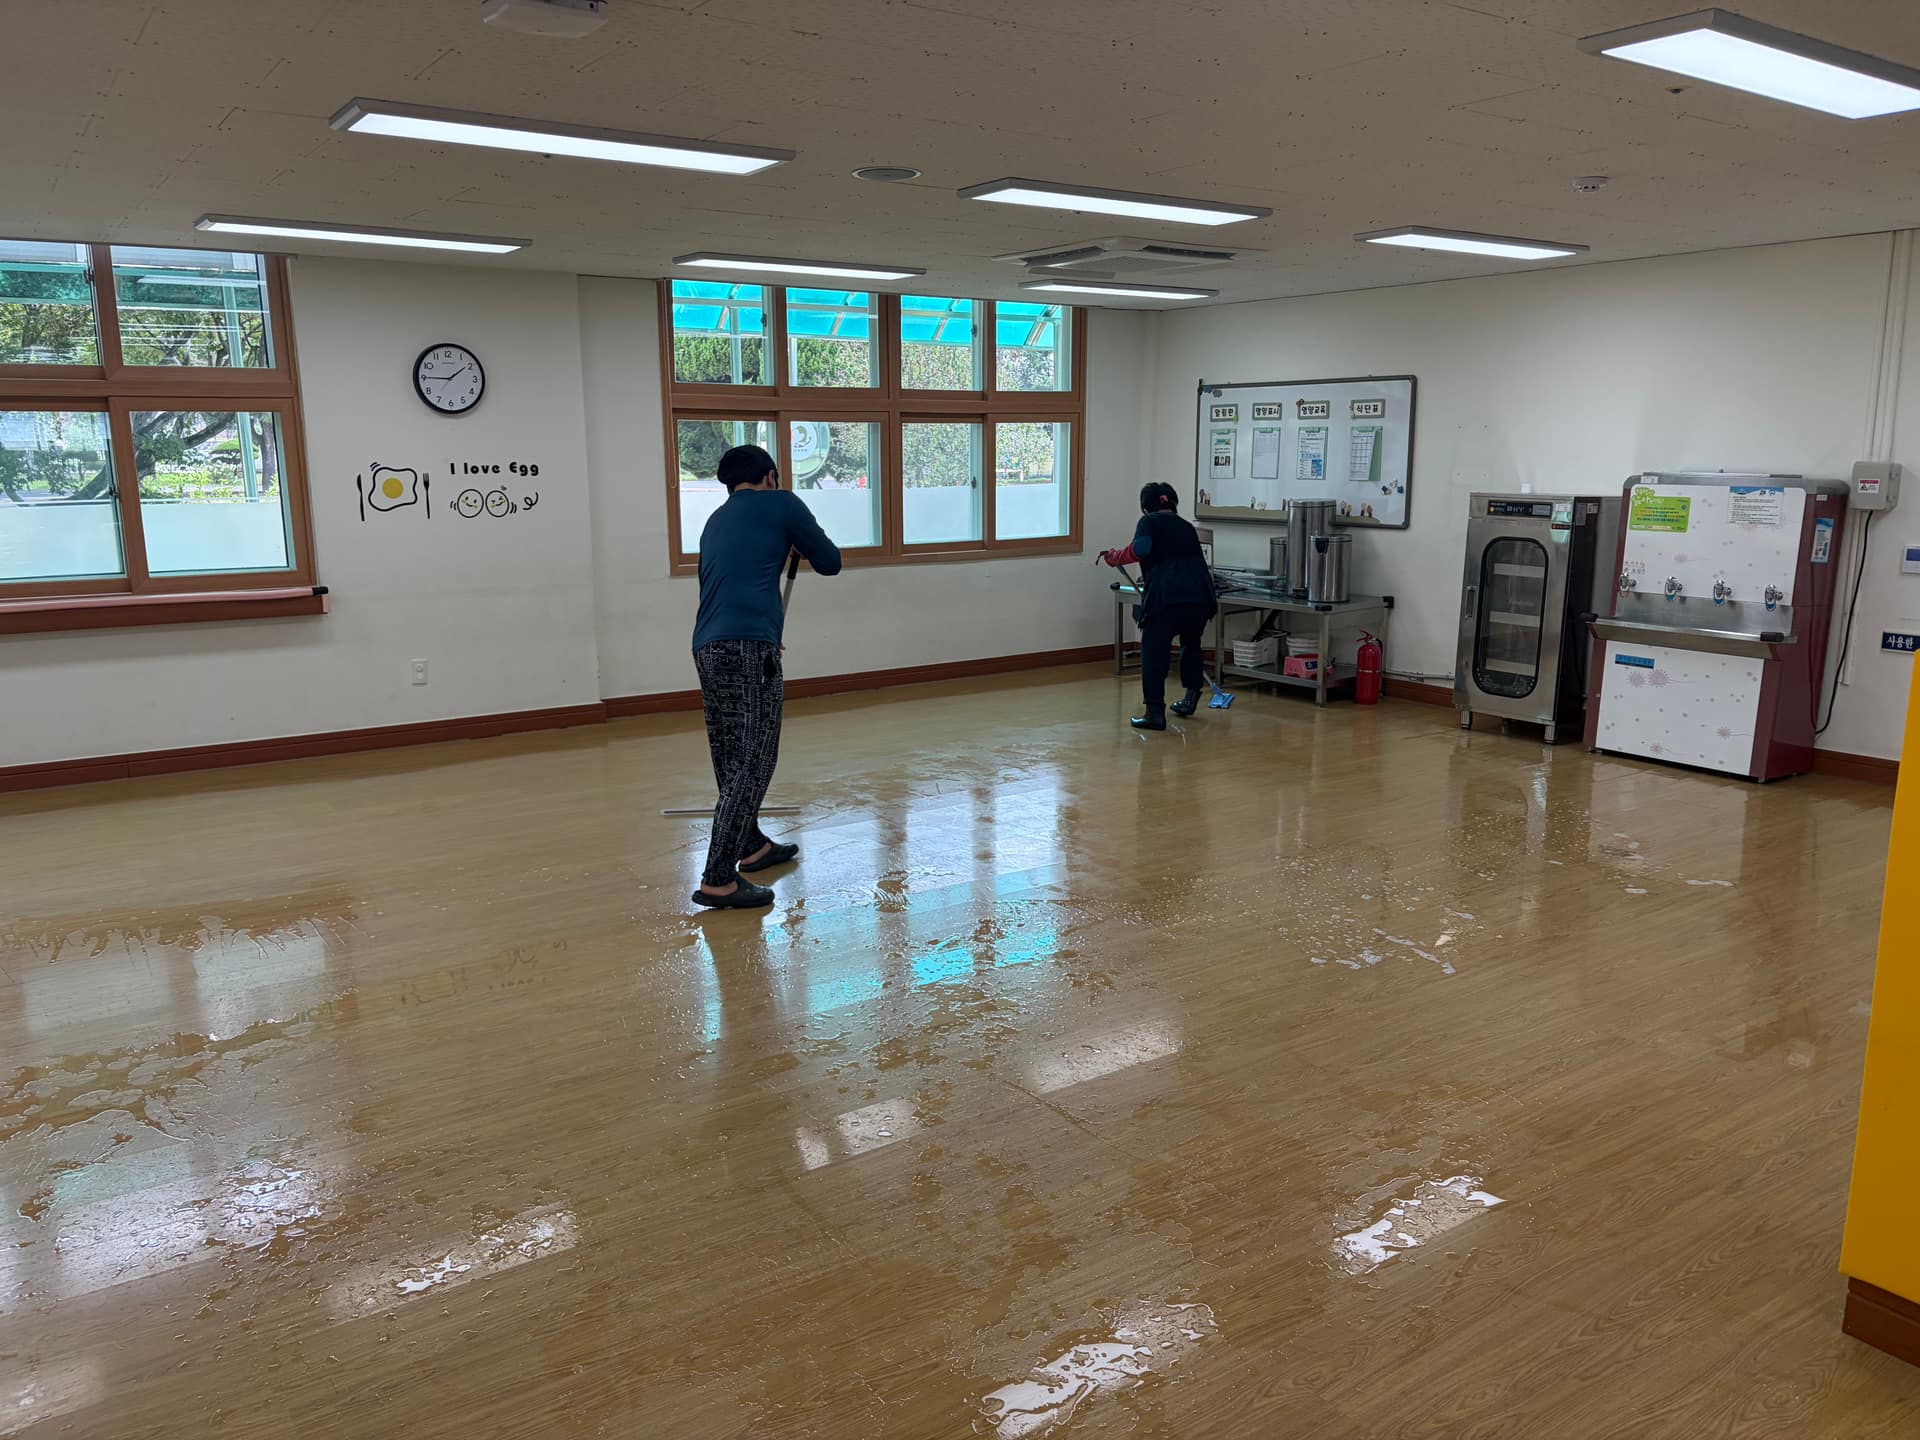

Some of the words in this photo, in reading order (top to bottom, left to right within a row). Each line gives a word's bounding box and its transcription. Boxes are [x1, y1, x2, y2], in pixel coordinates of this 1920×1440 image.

[1356, 404, 1379, 414] 식단표
[450, 462, 455, 475] I
[463, 462, 501, 475] love
[509, 461, 539, 477] Egg
